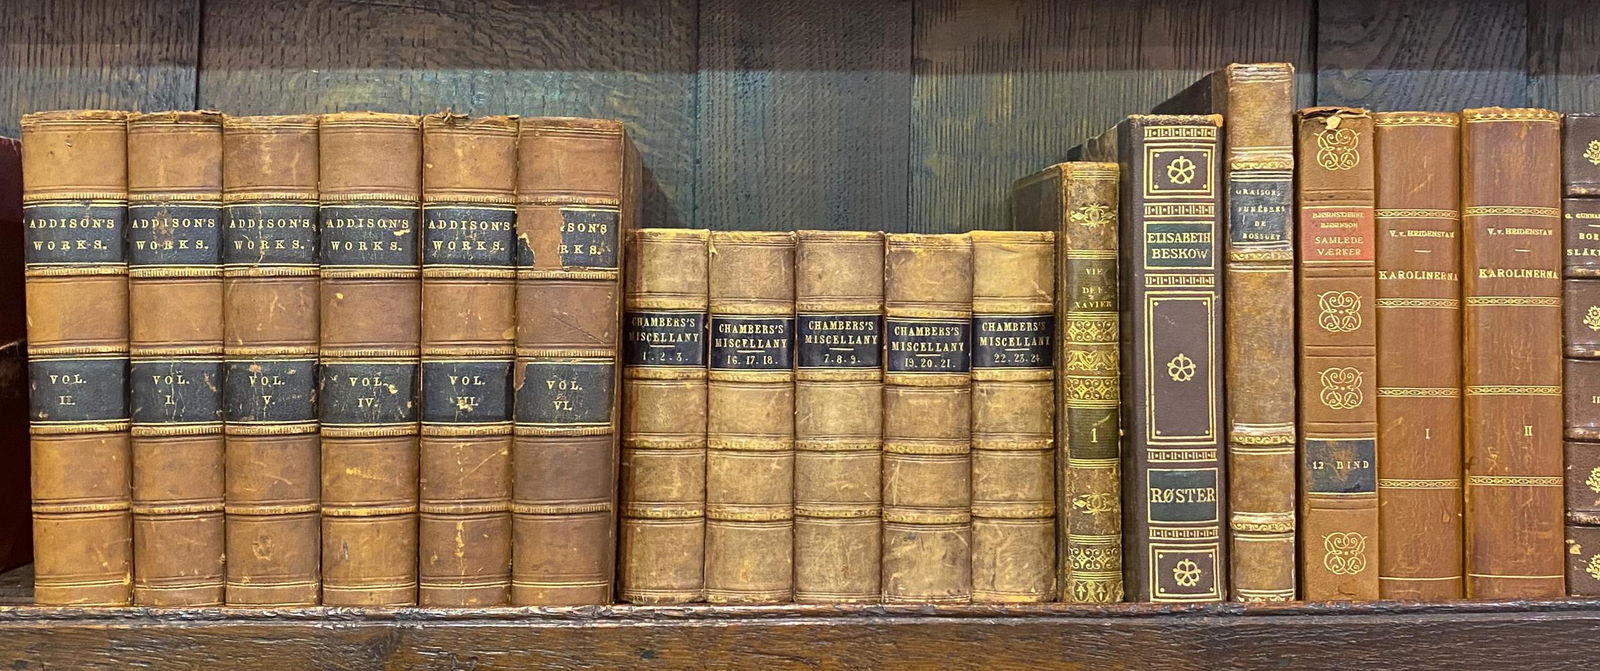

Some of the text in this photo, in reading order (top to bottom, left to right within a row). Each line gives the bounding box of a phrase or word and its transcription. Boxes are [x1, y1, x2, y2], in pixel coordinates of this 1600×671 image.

[29, 219, 115, 229] ADDISON'S
[132, 219, 215, 229] ADDISON'S
[229, 218, 310, 229] ADDISON'S
[326, 218, 409, 229] ADDISON'S
[428, 220, 510, 231] ADDISON'S
[1147, 232, 1211, 243] ELISABETH
[1242, 232, 1280, 240] BOSSUET
[1314, 236, 1364, 244] SAMLEDE
[34, 241, 107, 250] WORKS.
[136, 240, 209, 250] WORKS.
[234, 240, 304, 250] WORKS.
[331, 241, 402, 251] WORKS.
[432, 240, 504, 251] WORKS.
[1151, 248, 1210, 259] BESKOW
[1317, 248, 1361, 256] VÆRKER
[1379, 270, 1458, 280] KAROLINERNA
[1479, 268, 1558, 279] KAROLINERNA
[1075, 300, 1112, 309] XAVIER
[632, 317, 696, 328] CHAMBERS'S
[808, 320, 874, 331] CHAMBERS'S
[982, 322, 1046, 332] CHAMBERS'S
[719, 323, 784, 334] CHAMBERS'S
[894, 326, 959, 336] CHAMBERS'S
[629, 331, 699, 343] MISCELLANY
[805, 334, 878, 345] MISCELLANY
[979, 336, 1050, 347] MISCELLANY
[715, 338, 788, 349] MISCELLANY
[892, 341, 964, 352] MISCELLANY
[49, 374, 87, 384] VOL.
[152, 374, 189, 385] VOL.
[249, 376, 285, 386] VOL.
[349, 376, 386, 387] VOL.
[449, 375, 486, 386] VOL.
[547, 380, 583, 390] VOL.
[262, 395, 275, 405] V.
[358, 398, 378, 408] IV.
[1425, 428, 1430, 439] I
[1524, 425, 1533, 436] II
[1312, 460, 1369, 470] 12 BIND
[1150, 487, 1216, 503] RØSTER
